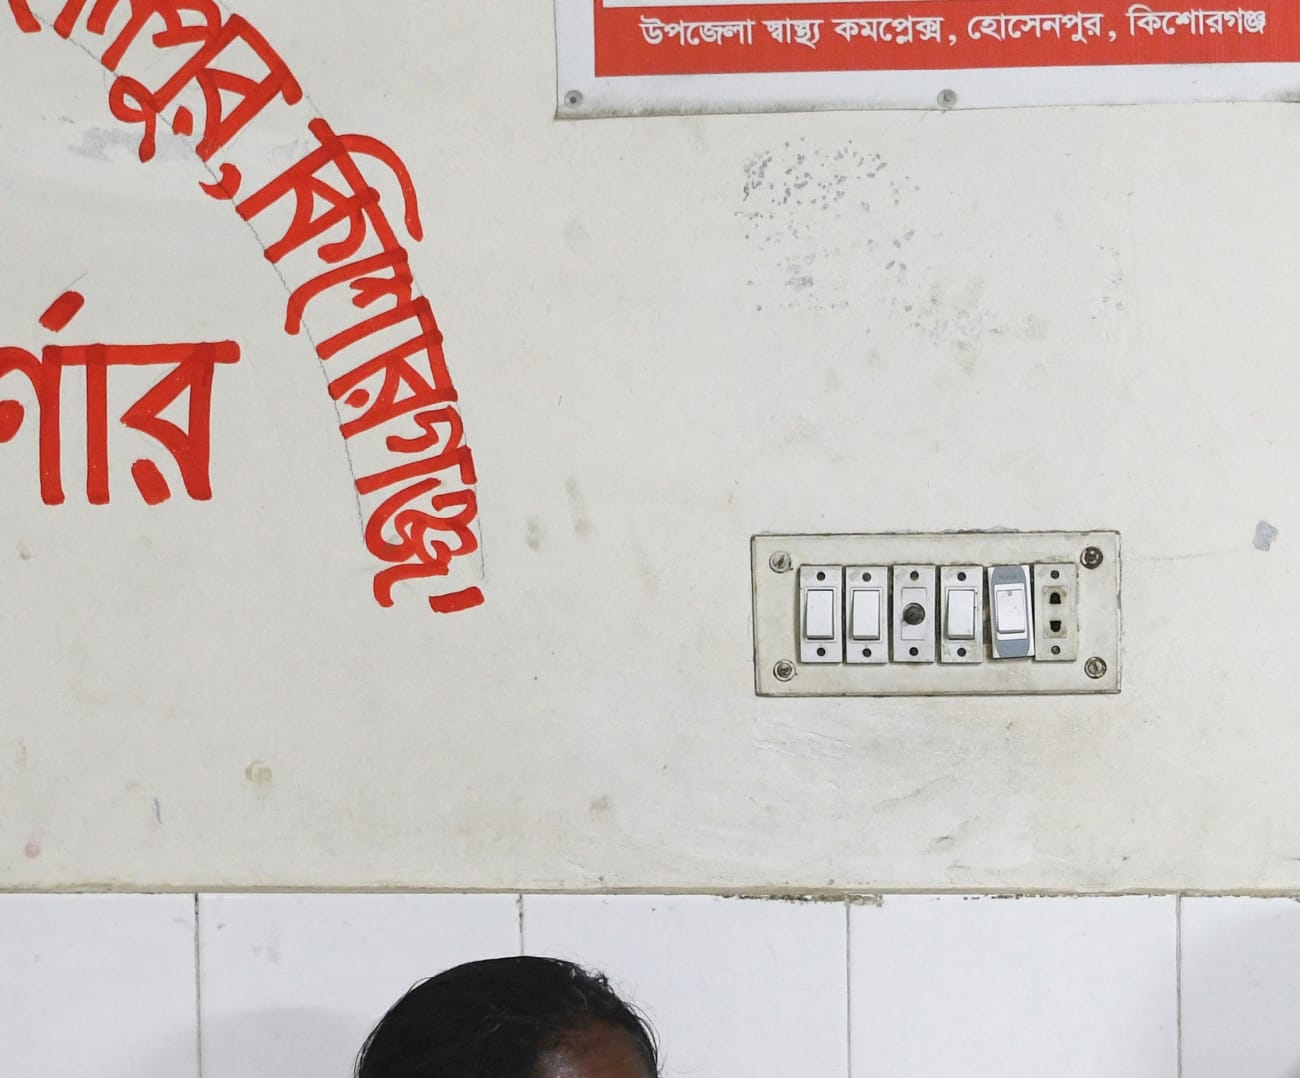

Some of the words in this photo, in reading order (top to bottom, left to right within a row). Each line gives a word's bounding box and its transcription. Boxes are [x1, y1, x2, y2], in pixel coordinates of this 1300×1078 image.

[639, 15, 756, 46] উপজেলা
[762, 18, 824, 49] স্বাস্থ্য
[1125, 4, 1266, 36] কিশোরগঞ্জ
